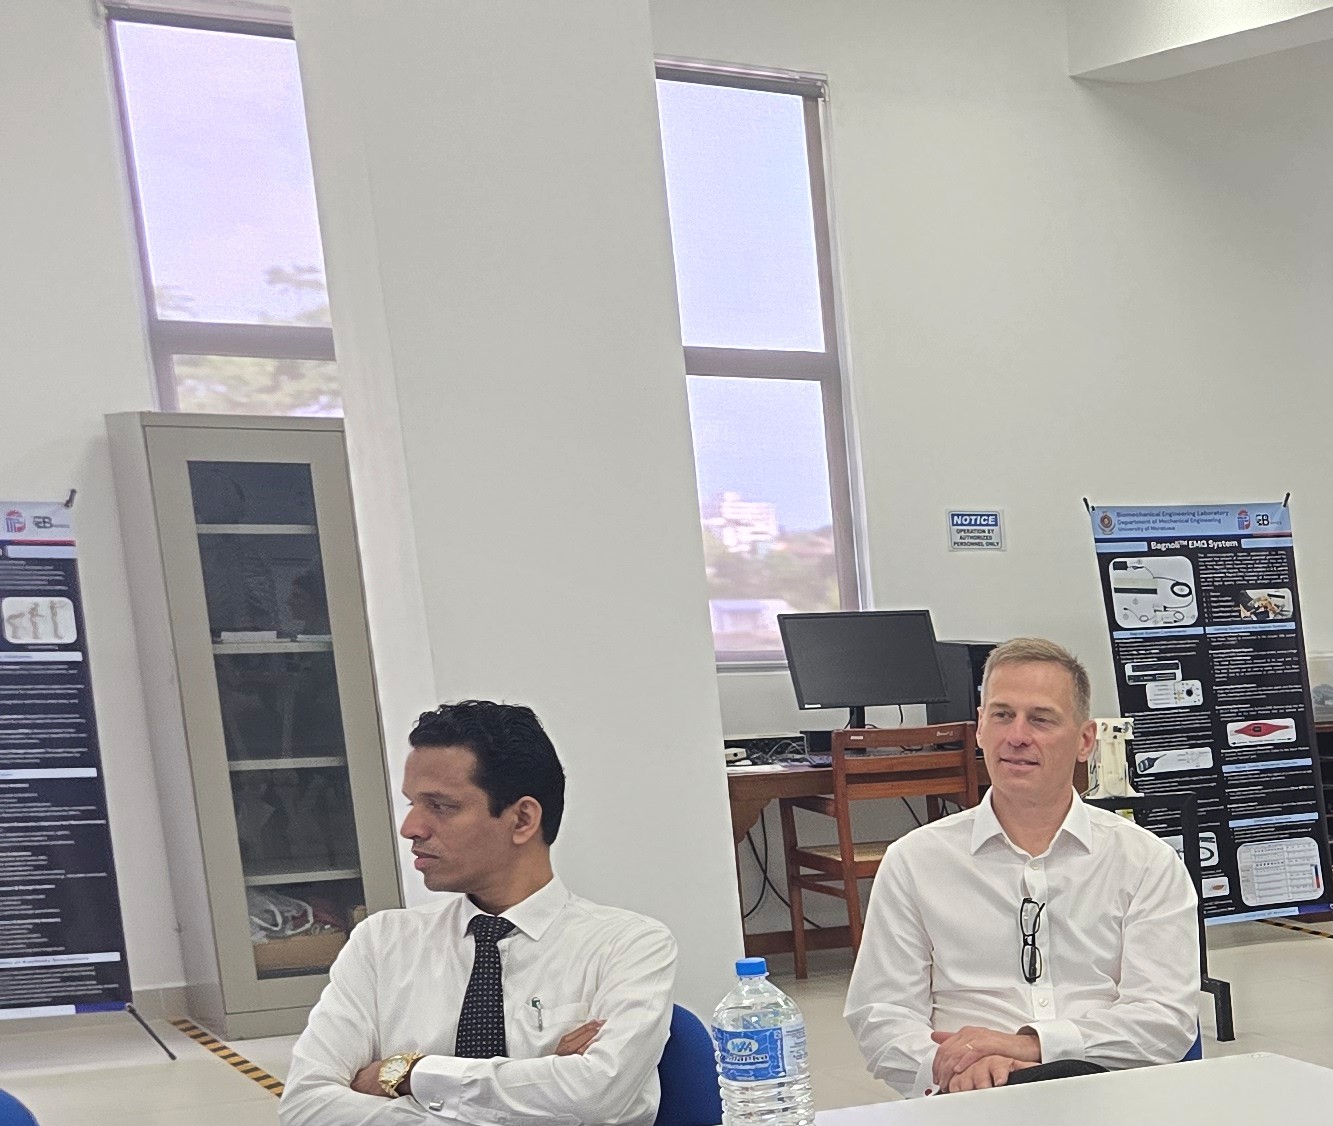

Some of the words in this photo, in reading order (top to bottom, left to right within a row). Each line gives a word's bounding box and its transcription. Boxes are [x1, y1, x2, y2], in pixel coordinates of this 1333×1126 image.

[1161, 510, 1196, 518] Engineering
[953, 515, 996, 525] NOTICE
[1188, 540, 1208, 549] EMG
[1208, 539, 1239, 550] System
